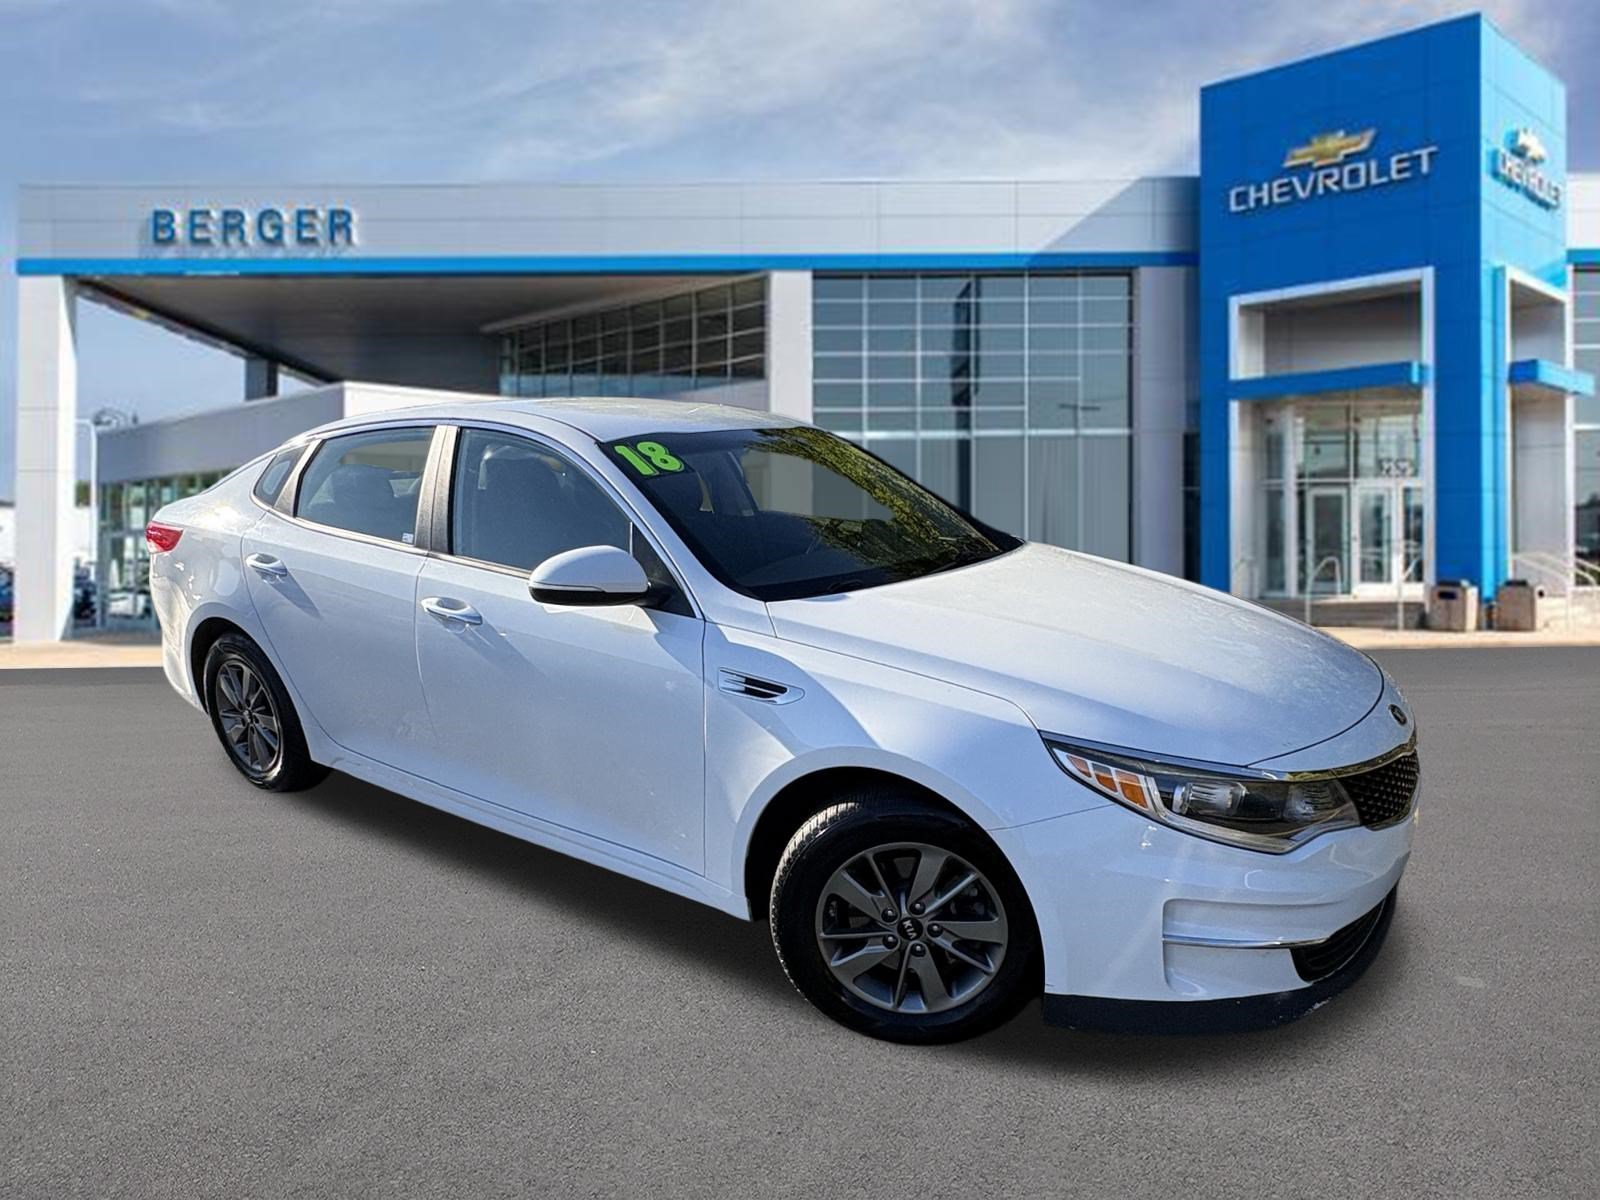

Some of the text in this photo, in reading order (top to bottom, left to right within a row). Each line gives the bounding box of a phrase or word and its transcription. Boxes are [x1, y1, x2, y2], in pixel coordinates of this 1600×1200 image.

[1228, 146, 1438, 212] CHEVROLET
[152, 208, 355, 246] BERGER
[614, 441, 684, 476] 18
[902, 919, 918, 940] KIA
